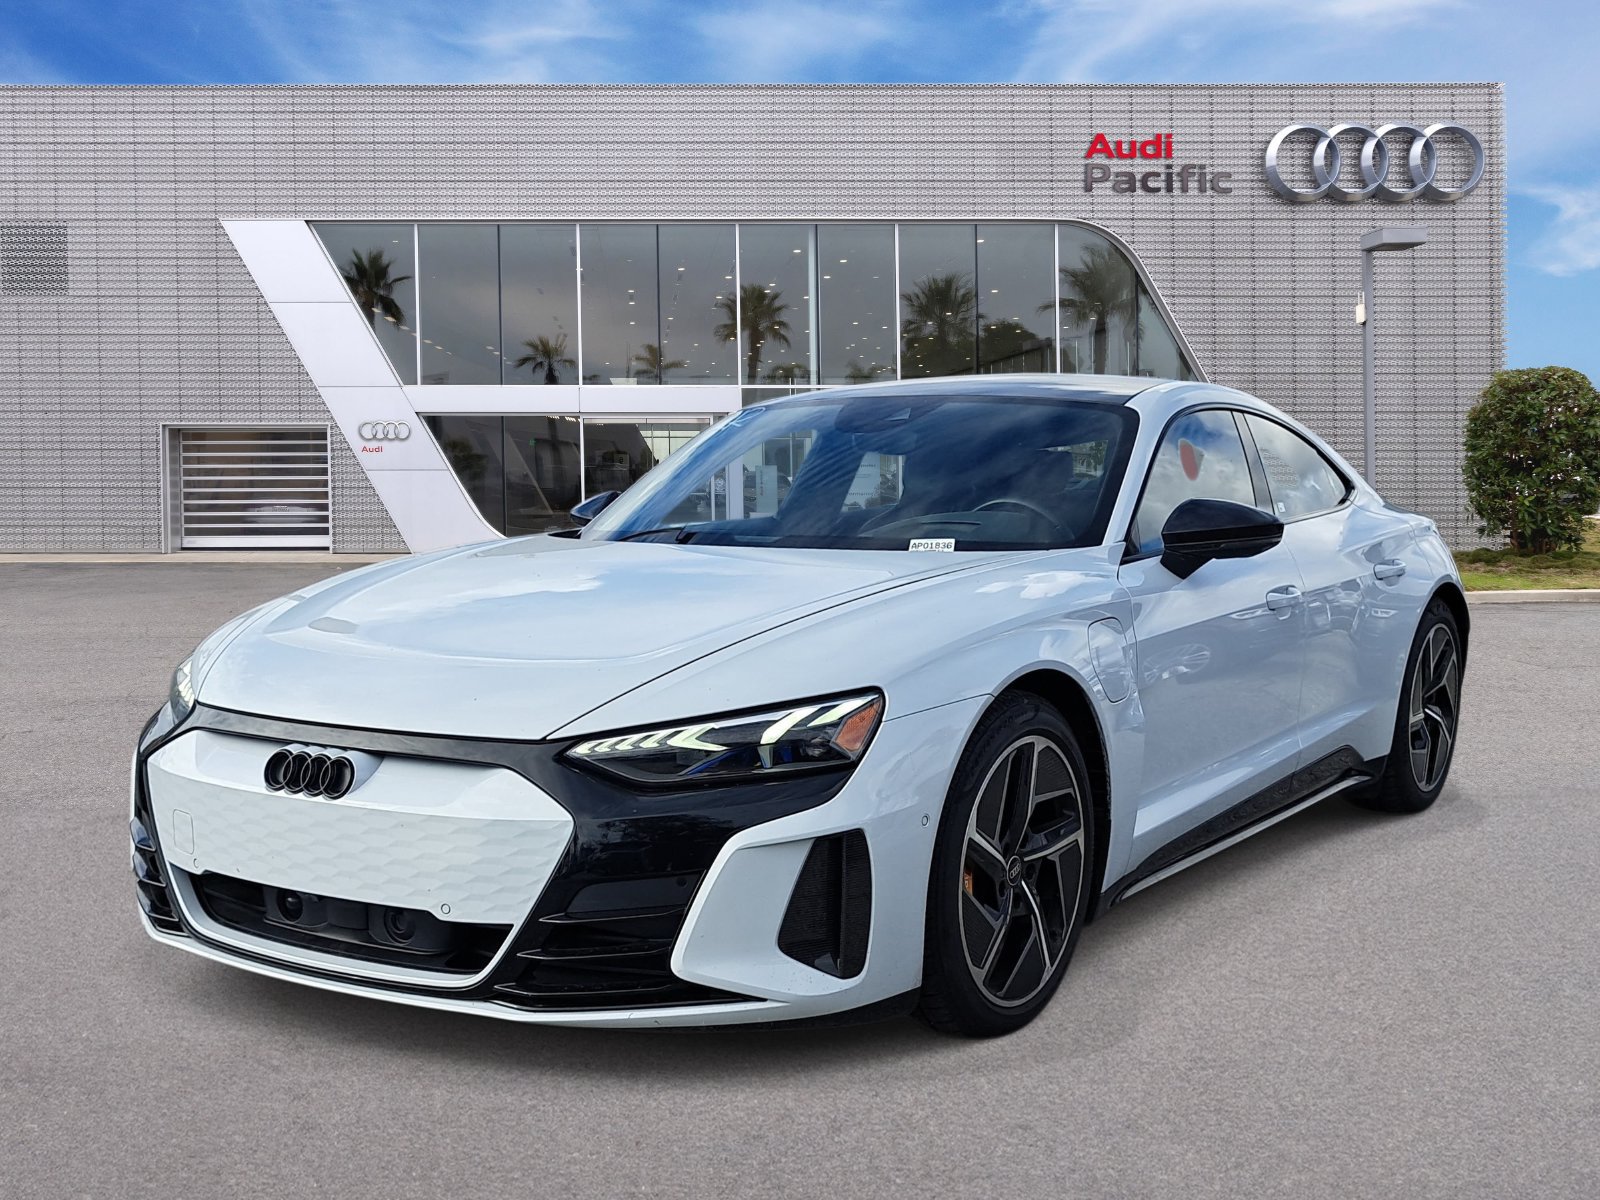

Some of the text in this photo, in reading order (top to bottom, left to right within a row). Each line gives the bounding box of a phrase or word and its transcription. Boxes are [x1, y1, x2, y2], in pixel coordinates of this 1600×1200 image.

[1085, 132, 1174, 160] Audi
[1084, 163, 1233, 194] Pacific
[361, 445, 383, 453] Audi
